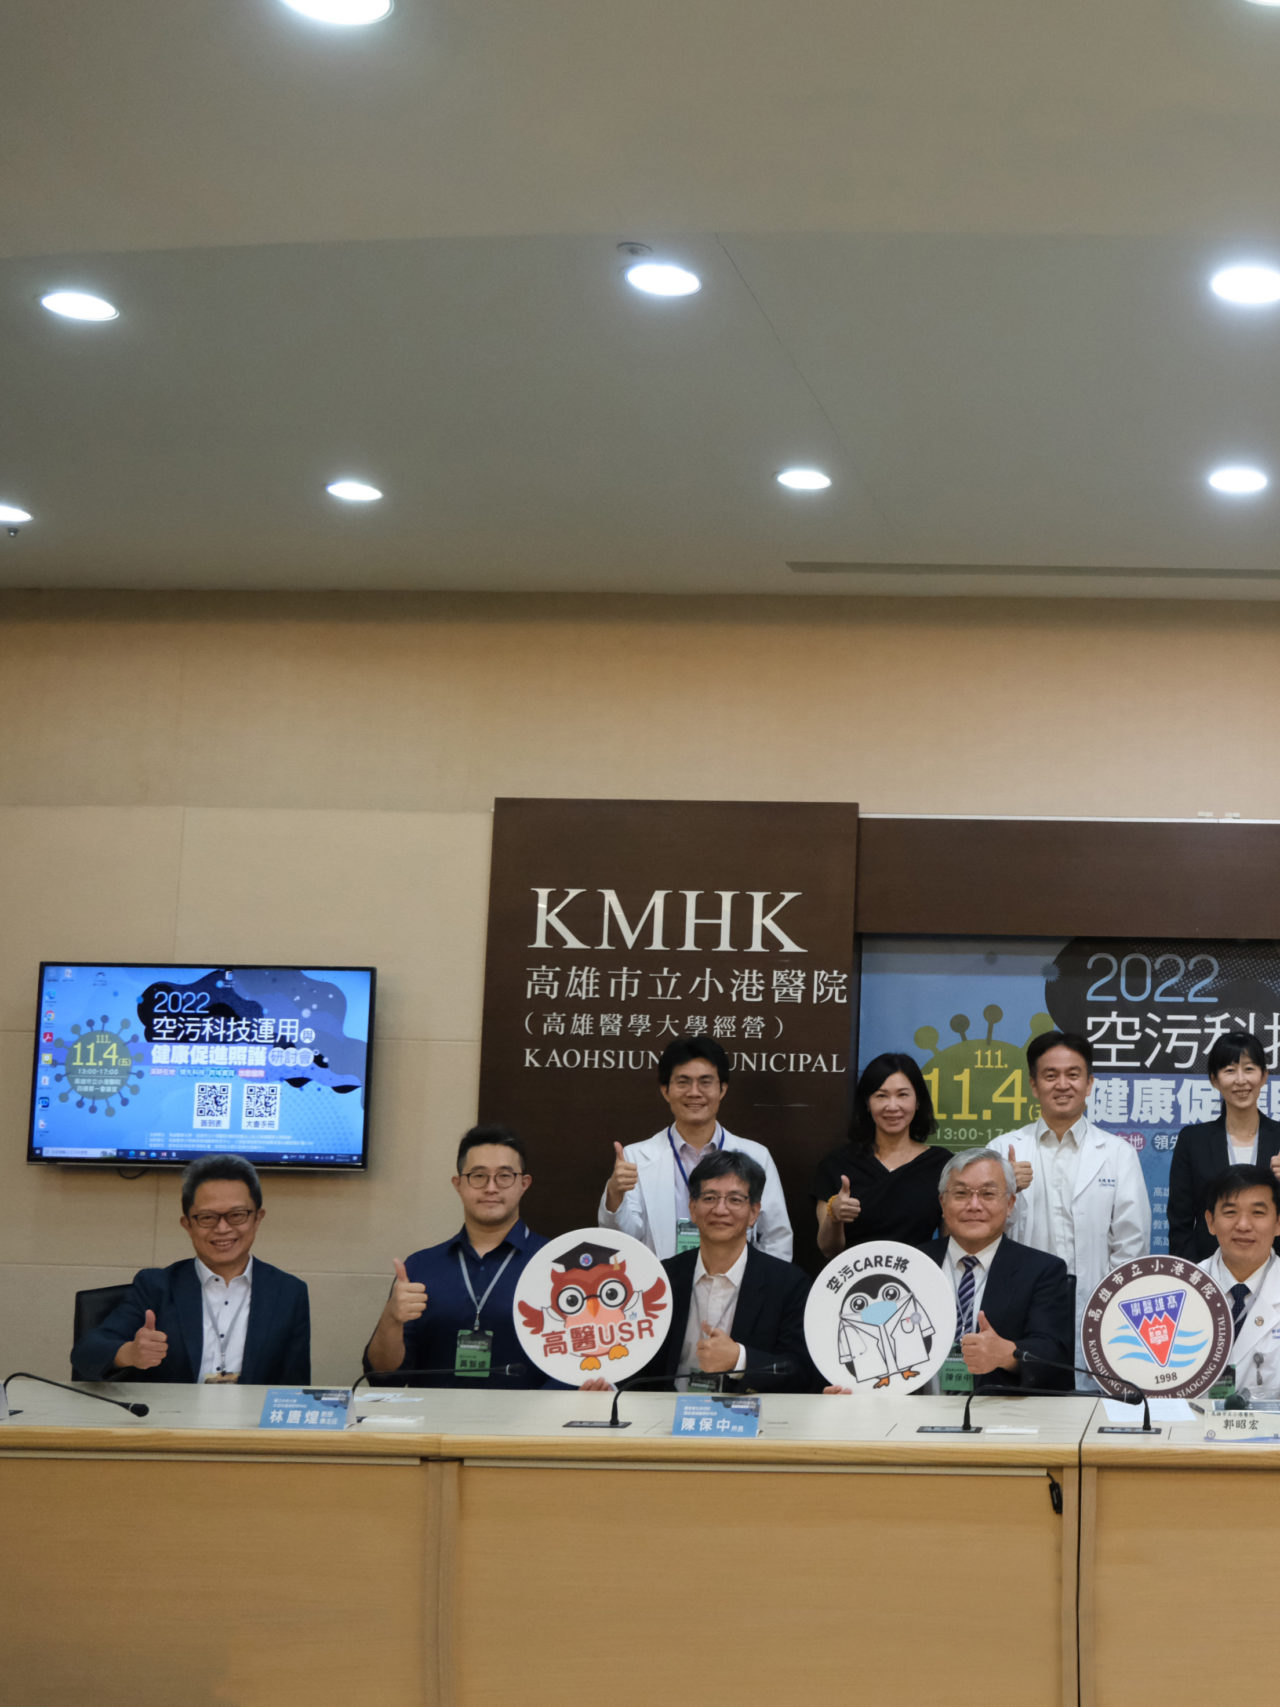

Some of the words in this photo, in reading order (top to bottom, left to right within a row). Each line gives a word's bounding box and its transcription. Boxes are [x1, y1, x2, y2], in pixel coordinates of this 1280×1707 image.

[527, 887, 808, 953] KMHK
[525, 964, 848, 1004] 高雄市立小港醫院
[1086, 952, 1220, 1003] 2022
[154, 991, 210, 1014] 2022
[523, 1048, 662, 1070] KAOHSIUN
[728, 1052, 846, 1073] UNICIPAL
[974, 1049, 1008, 1069] 111.
[826, 1254, 910, 1294] 空污CARE將
[1088, 1258, 1217, 1322] 高雄市立小港醫院
[541, 1318, 655, 1358] 高醫USR
[1213, 1314, 1227, 1363] HOSPITAL
[1153, 1372, 1178, 1385] 1998
[681, 1418, 731, 1432] 陳保中
[1223, 1419, 1259, 1431] 郭昭宏
